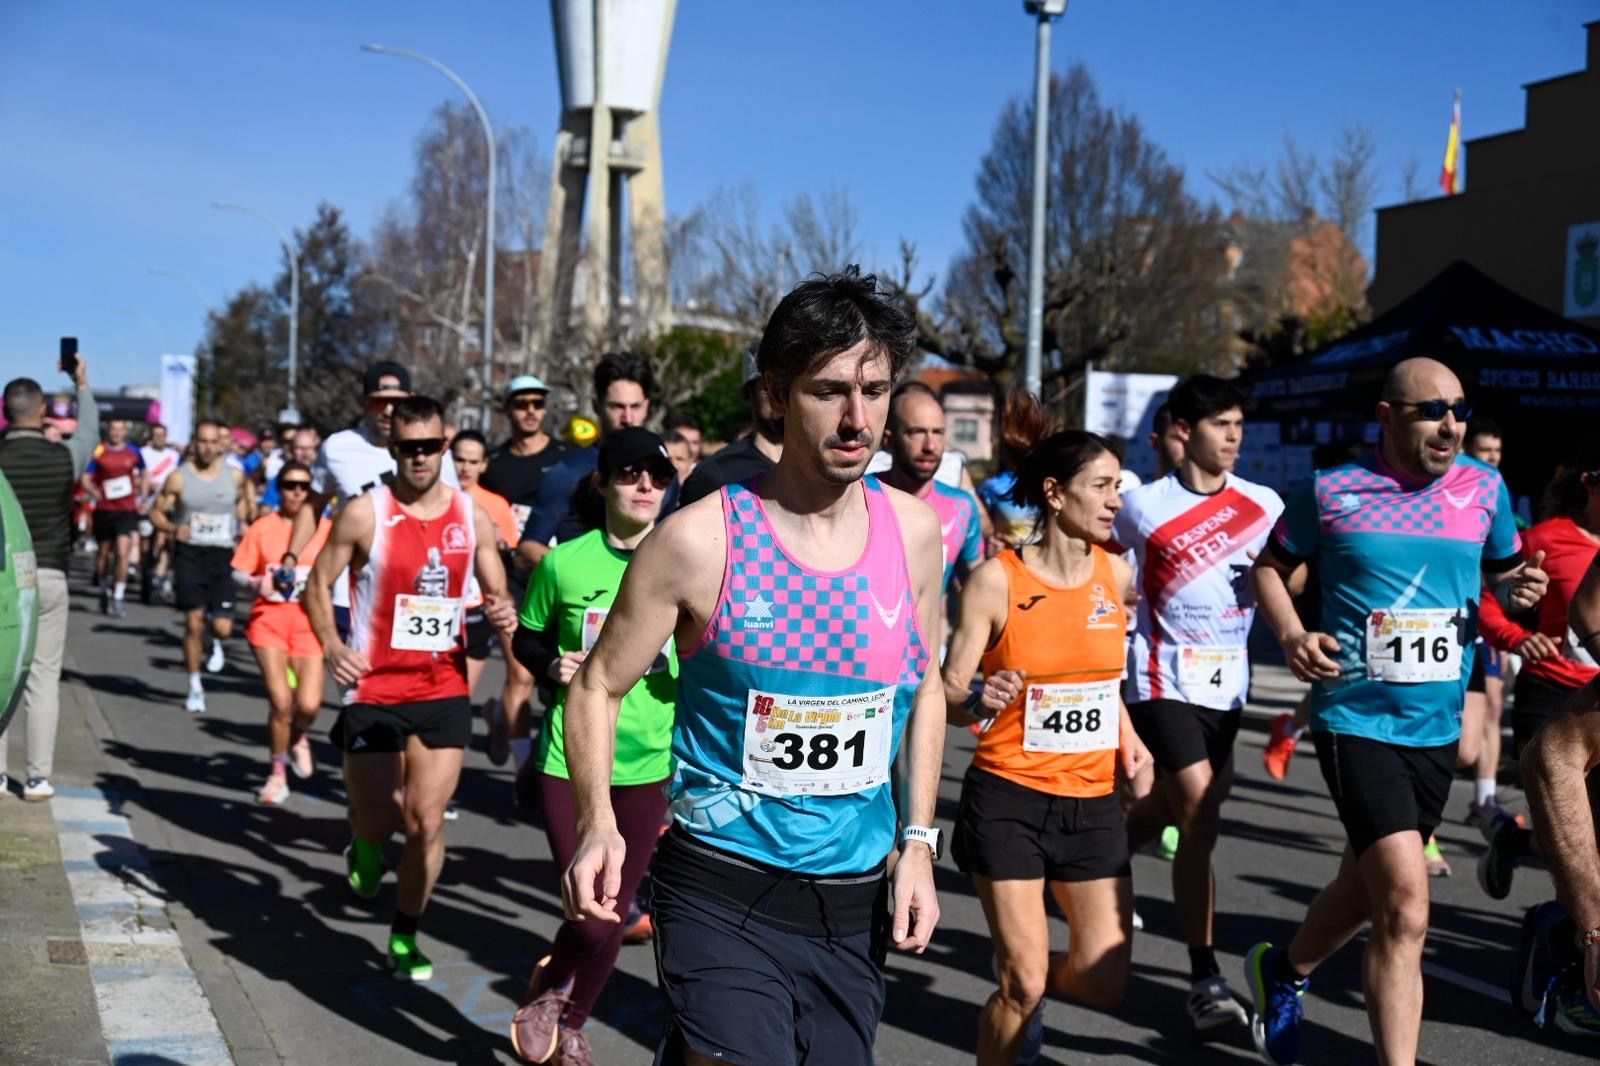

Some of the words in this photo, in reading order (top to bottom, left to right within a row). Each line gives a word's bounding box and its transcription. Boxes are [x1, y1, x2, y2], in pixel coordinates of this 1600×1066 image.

[1448, 325, 1598, 354] MACHO
[1186, 530, 1238, 567] FER
[408, 616, 453, 637] 331
[743, 619, 774, 629] luanvi
[1386, 636, 1449, 663] 116
[1210, 667, 1222, 688] 4
[752, 694, 775, 716] 10
[787, 698, 797, 706] LA
[1042, 708, 1101, 734] 488
[772, 730, 866, 771] 381
